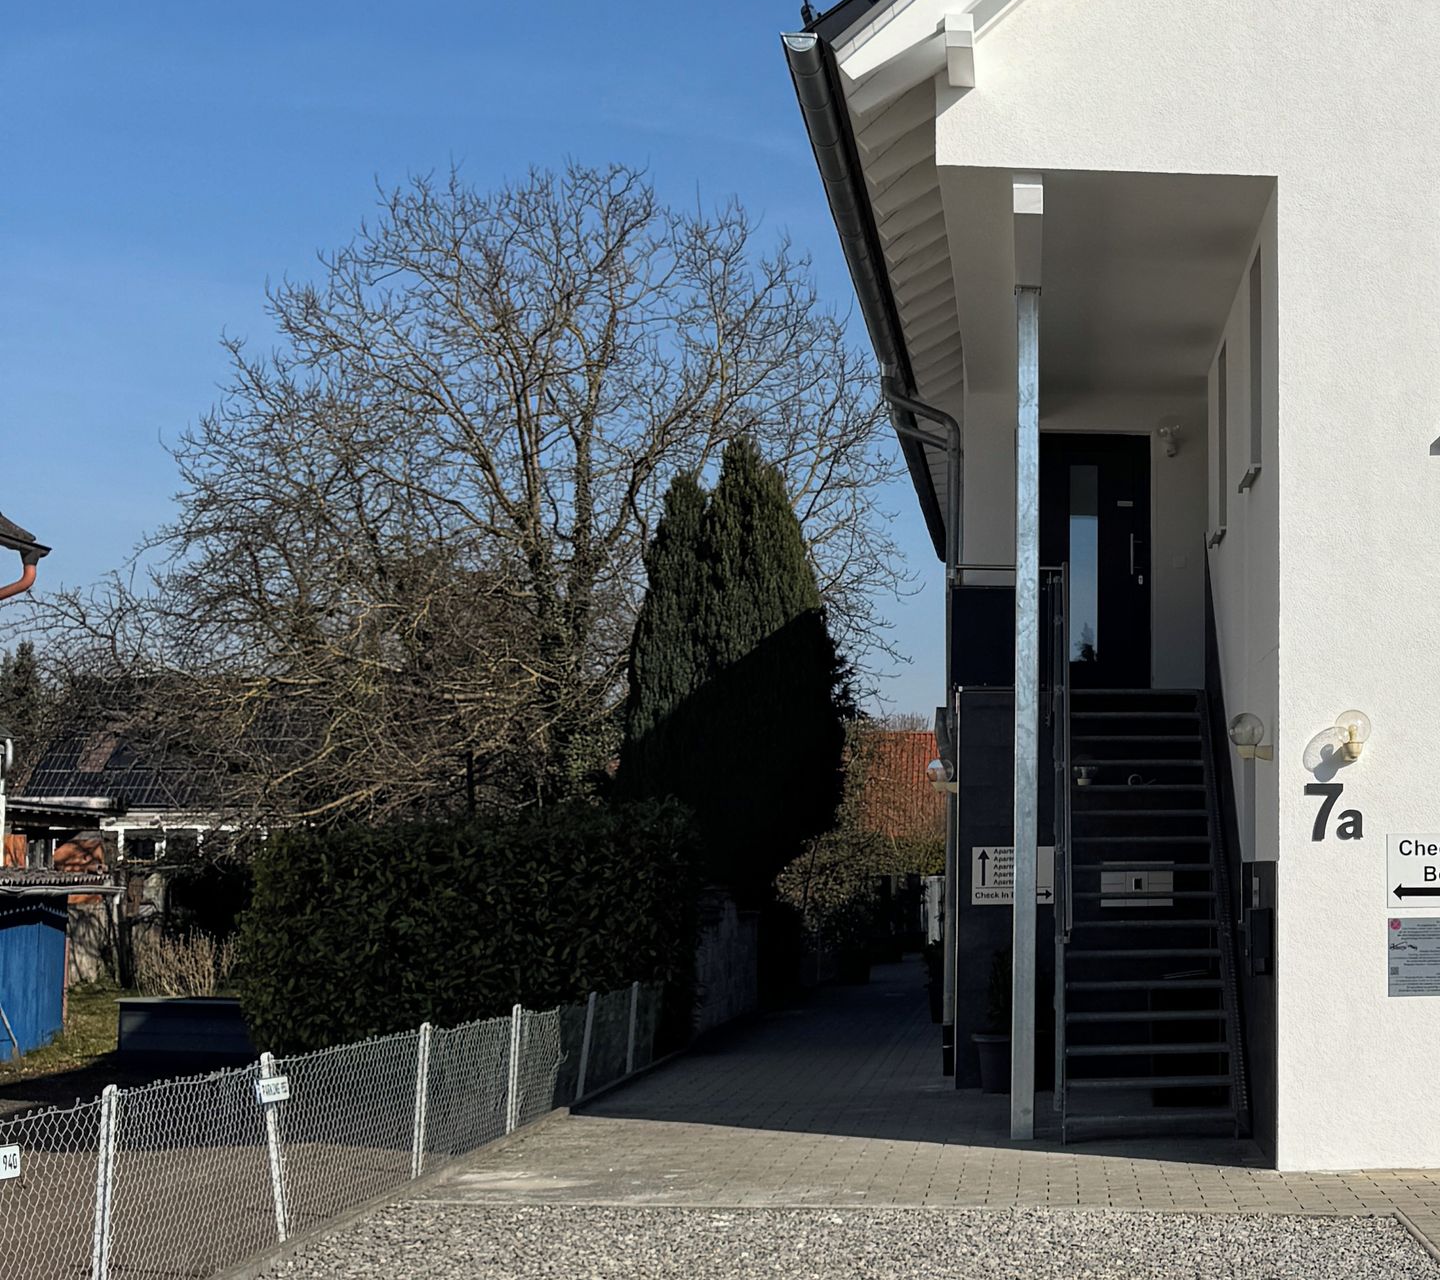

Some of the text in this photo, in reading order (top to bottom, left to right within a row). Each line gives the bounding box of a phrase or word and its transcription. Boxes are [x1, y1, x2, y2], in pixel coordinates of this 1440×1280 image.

[1304, 783, 1363, 842] 7a
[993, 848, 1014, 856] Apart
[975, 891, 999, 899] Check
